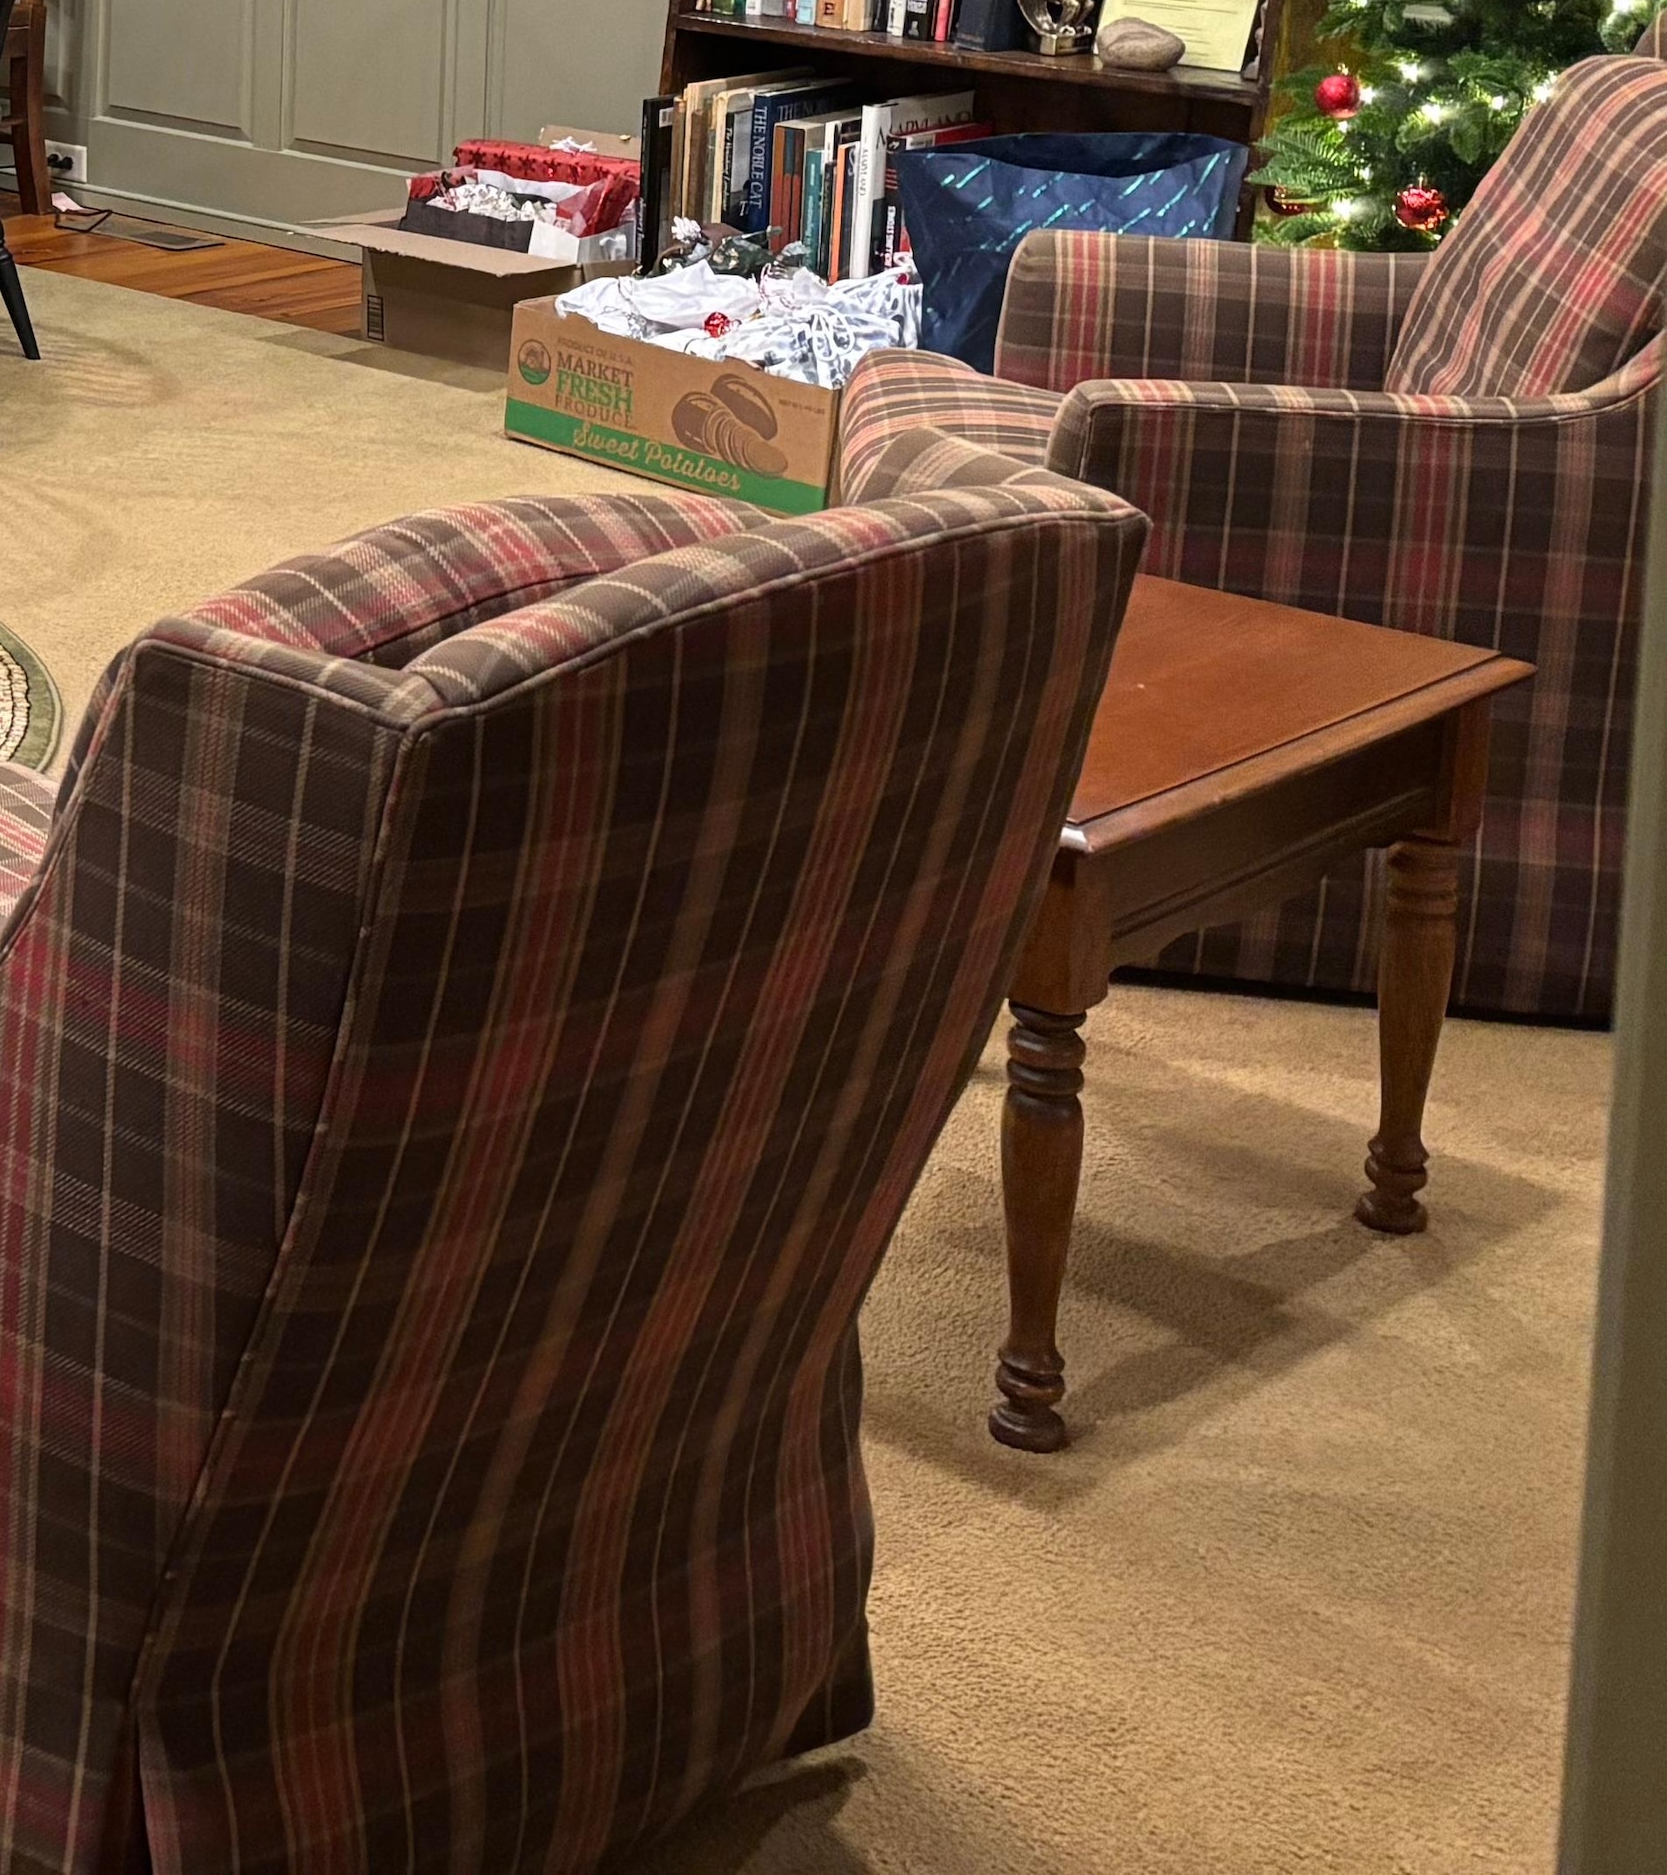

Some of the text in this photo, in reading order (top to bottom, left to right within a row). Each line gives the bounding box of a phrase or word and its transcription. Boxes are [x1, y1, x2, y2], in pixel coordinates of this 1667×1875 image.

[749, 106, 768, 209] THE NOBLE CAT
[556, 337, 595, 356] PRODUCT
[555, 368, 633, 413] FRESH
[556, 352, 634, 389] MARKET
[554, 394, 637, 430] PRODUCE
[572, 422, 742, 491] Sweet Potatoes
